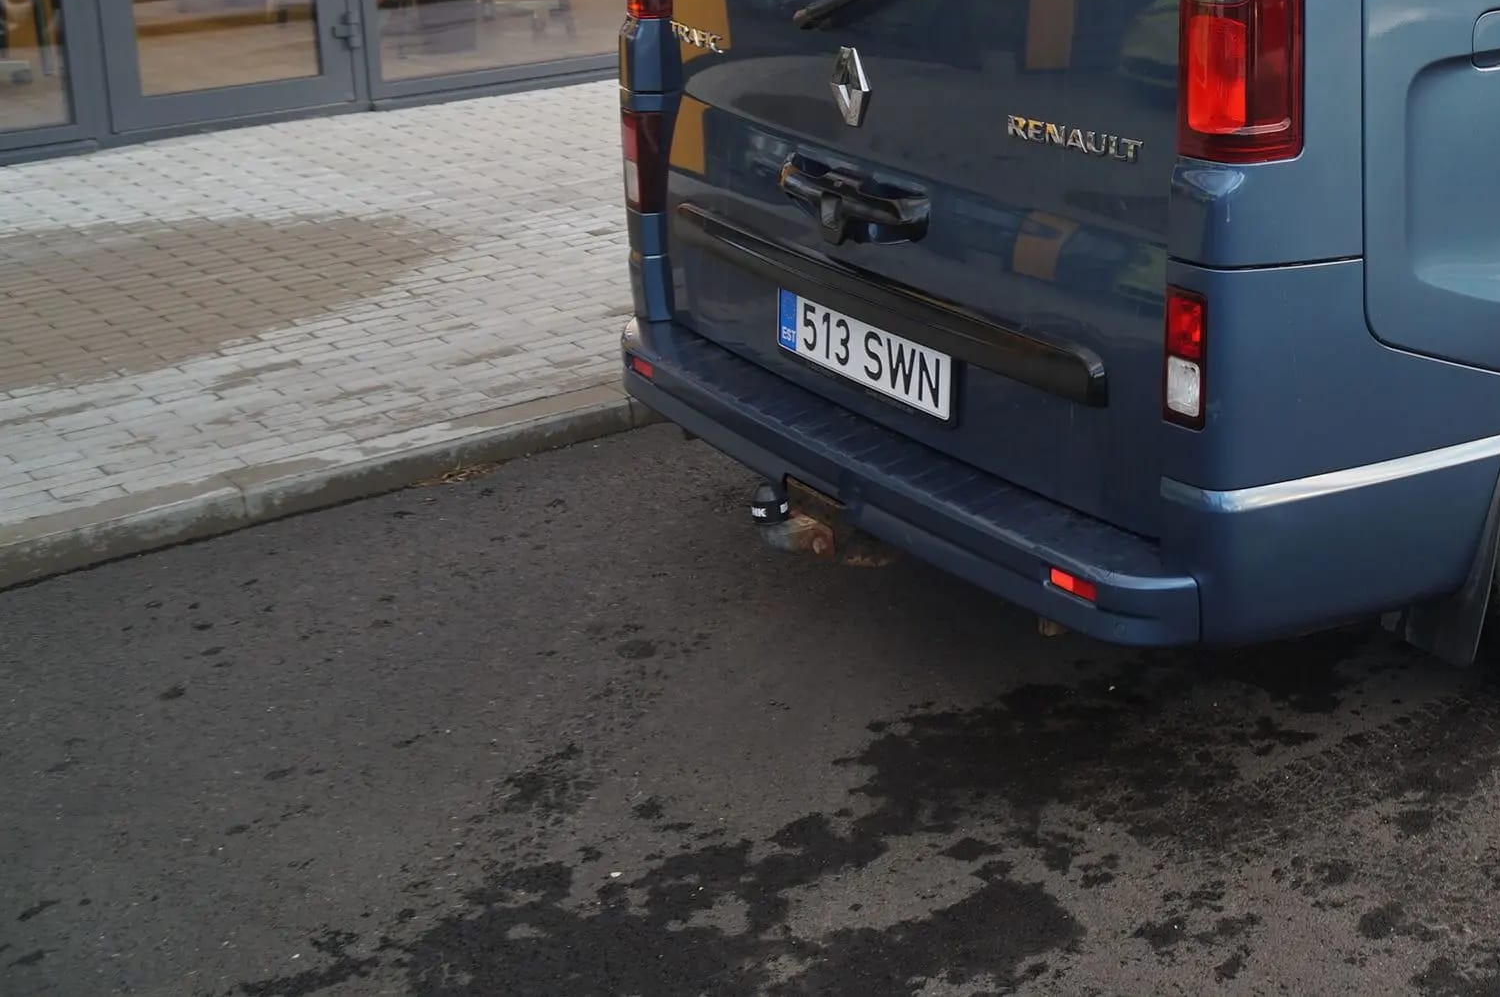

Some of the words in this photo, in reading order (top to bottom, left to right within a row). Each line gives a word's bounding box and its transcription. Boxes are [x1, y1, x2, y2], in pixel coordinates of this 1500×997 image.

[670, 20, 724, 54] TRAFIC
[1007, 114, 1145, 164] RENAULT
[782, 326, 797, 343] EST
[803, 303, 850, 366] 513
[864, 330, 941, 409] SWN
